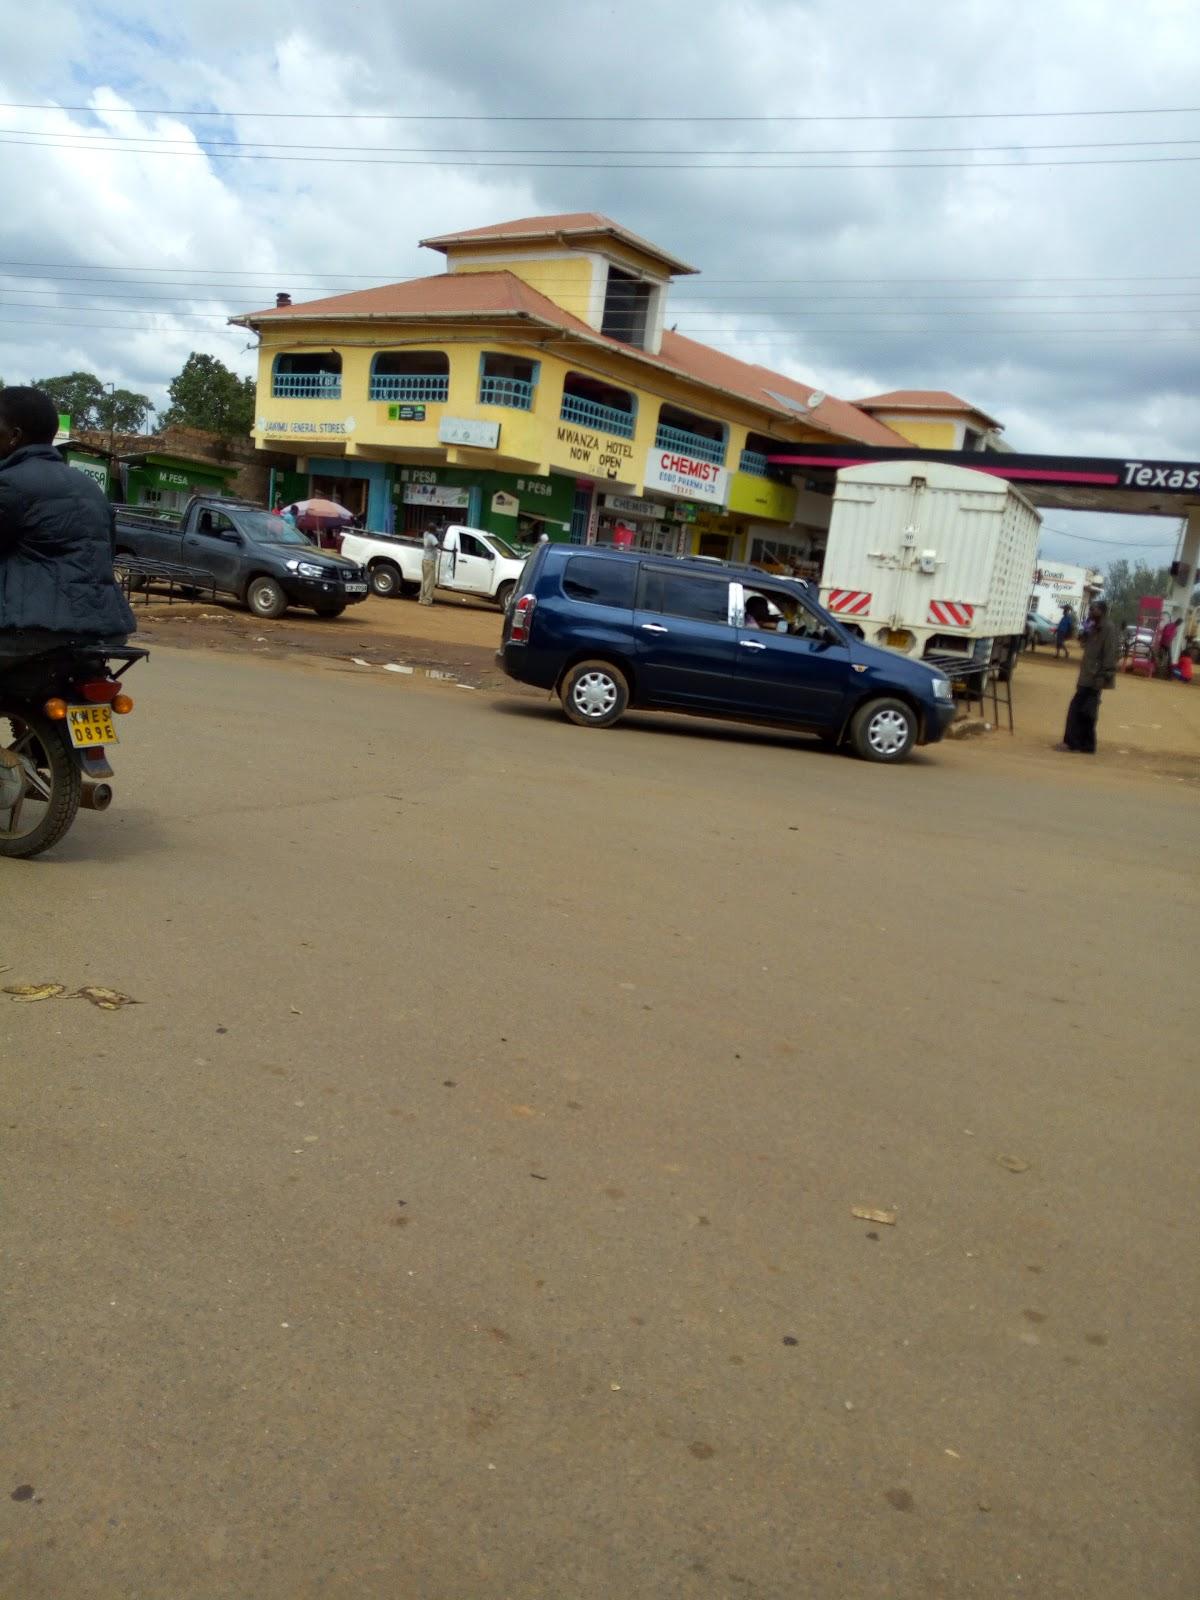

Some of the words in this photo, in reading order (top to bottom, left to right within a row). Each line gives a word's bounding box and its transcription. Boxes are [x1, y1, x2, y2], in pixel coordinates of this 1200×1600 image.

[557, 427, 599, 450] MWANZA
[606, 440, 633, 458] HOTEL
[570, 447, 591, 462] NOW
[599, 454, 622, 468] OPEN
[660, 453, 720, 482] CHEMIST
[413, 471, 437, 484] PESA
[528, 481, 553, 497] PESA
[75, 725, 114, 742] 089E
